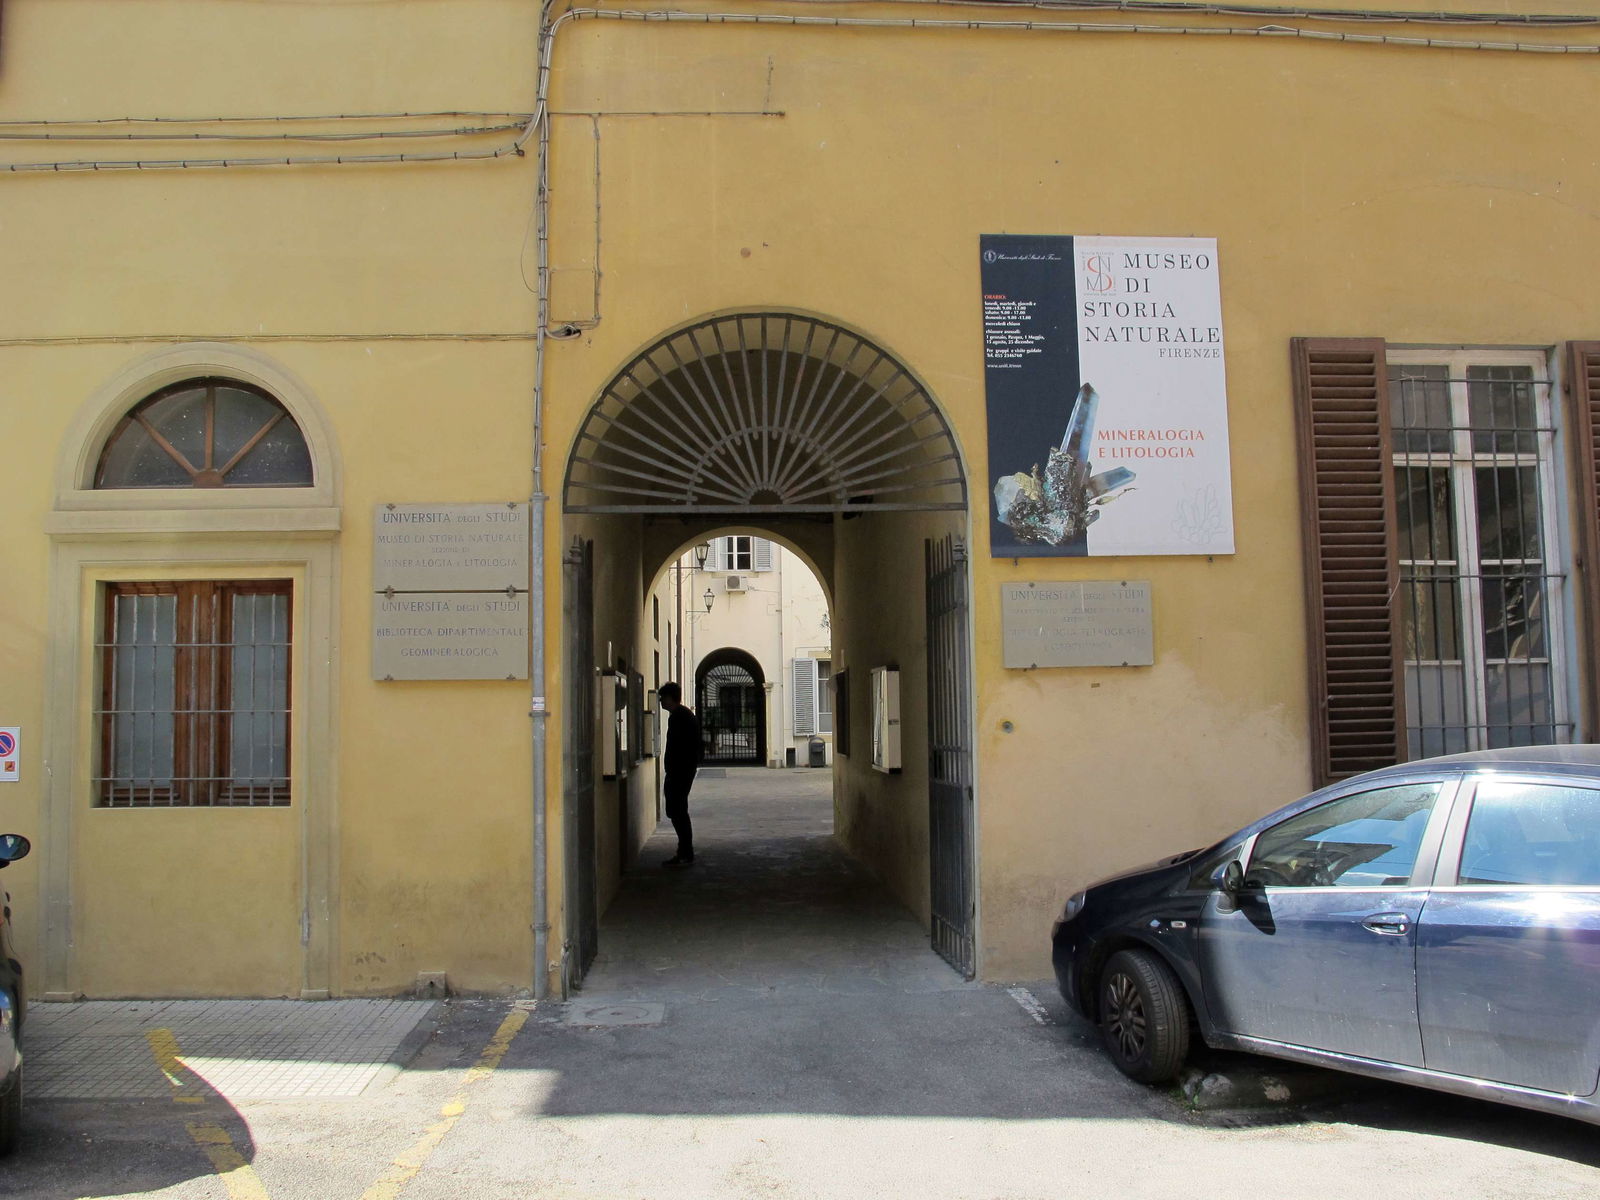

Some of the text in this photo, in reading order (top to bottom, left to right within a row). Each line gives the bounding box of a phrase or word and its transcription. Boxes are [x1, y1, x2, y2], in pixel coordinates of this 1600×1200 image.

[1124, 253, 1210, 270] MUSEO
[1125, 278, 1151, 293] DI
[1084, 302, 1176, 318] STORIA
[1085, 327, 1221, 343] NATURALE
[1159, 348, 1221, 359] FIRENZE
[1098, 429, 1205, 441] MINERALOGIA
[1099, 447, 1196, 458] E LITOLOGIA
[457, 515, 481, 523] DEGLI
[486, 511, 521, 523] STUDI
[377, 534, 525, 544] MUSEO DI STORIA NATURALE
[384, 558, 453, 568] MINERALOGIA
[464, 558, 518, 568] LITOLOGIA
[485, 600, 520, 612] STUDI
[376, 627, 525, 638] BIBLIOTECA DIPARTIMENTALE
[400, 648, 499, 657] GEOMINERALOGICA
